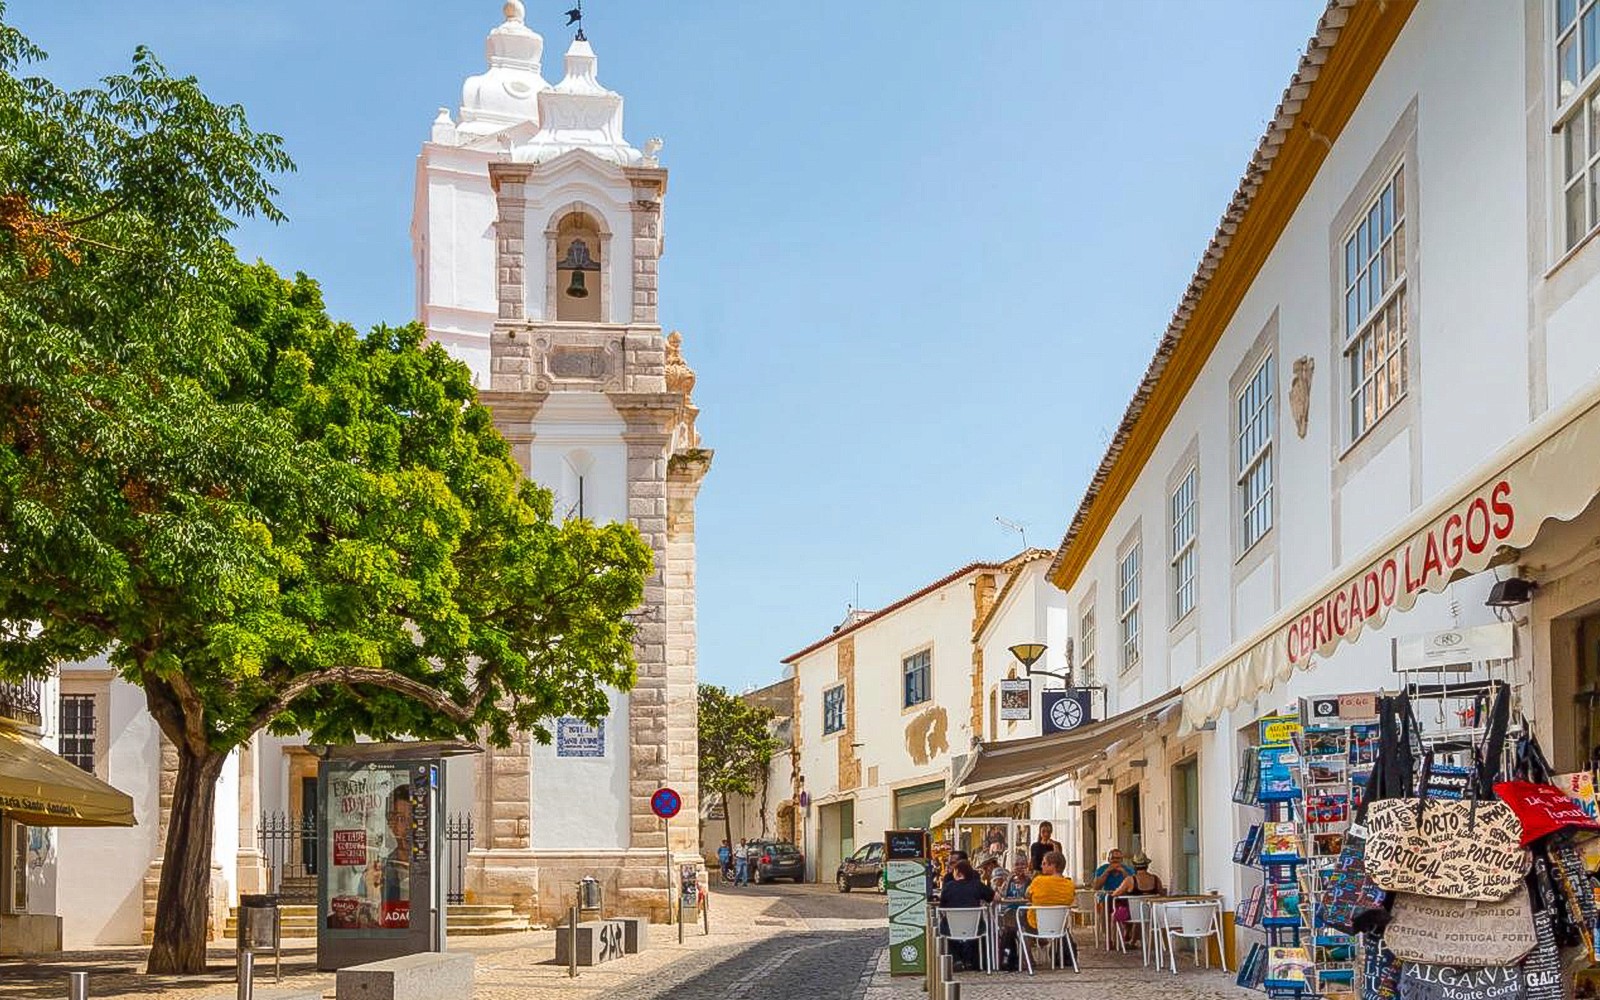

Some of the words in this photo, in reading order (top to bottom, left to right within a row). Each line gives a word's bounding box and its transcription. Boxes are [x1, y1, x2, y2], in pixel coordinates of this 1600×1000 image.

[1287, 558, 1397, 664] OBRIGADO
[1405, 480, 1514, 594] LAGOS
[1374, 841, 1442, 879] PORTUGAL
[1466, 843, 1525, 875] PORTUGAL
[1387, 924, 1439, 939] PORTUGAL
[1445, 933, 1497, 943] PORTUGAL
[1434, 953, 1488, 966] PORTUGAL
[1406, 963, 1518, 989] ALGARVE
[1442, 986, 1484, 1000] Monte
